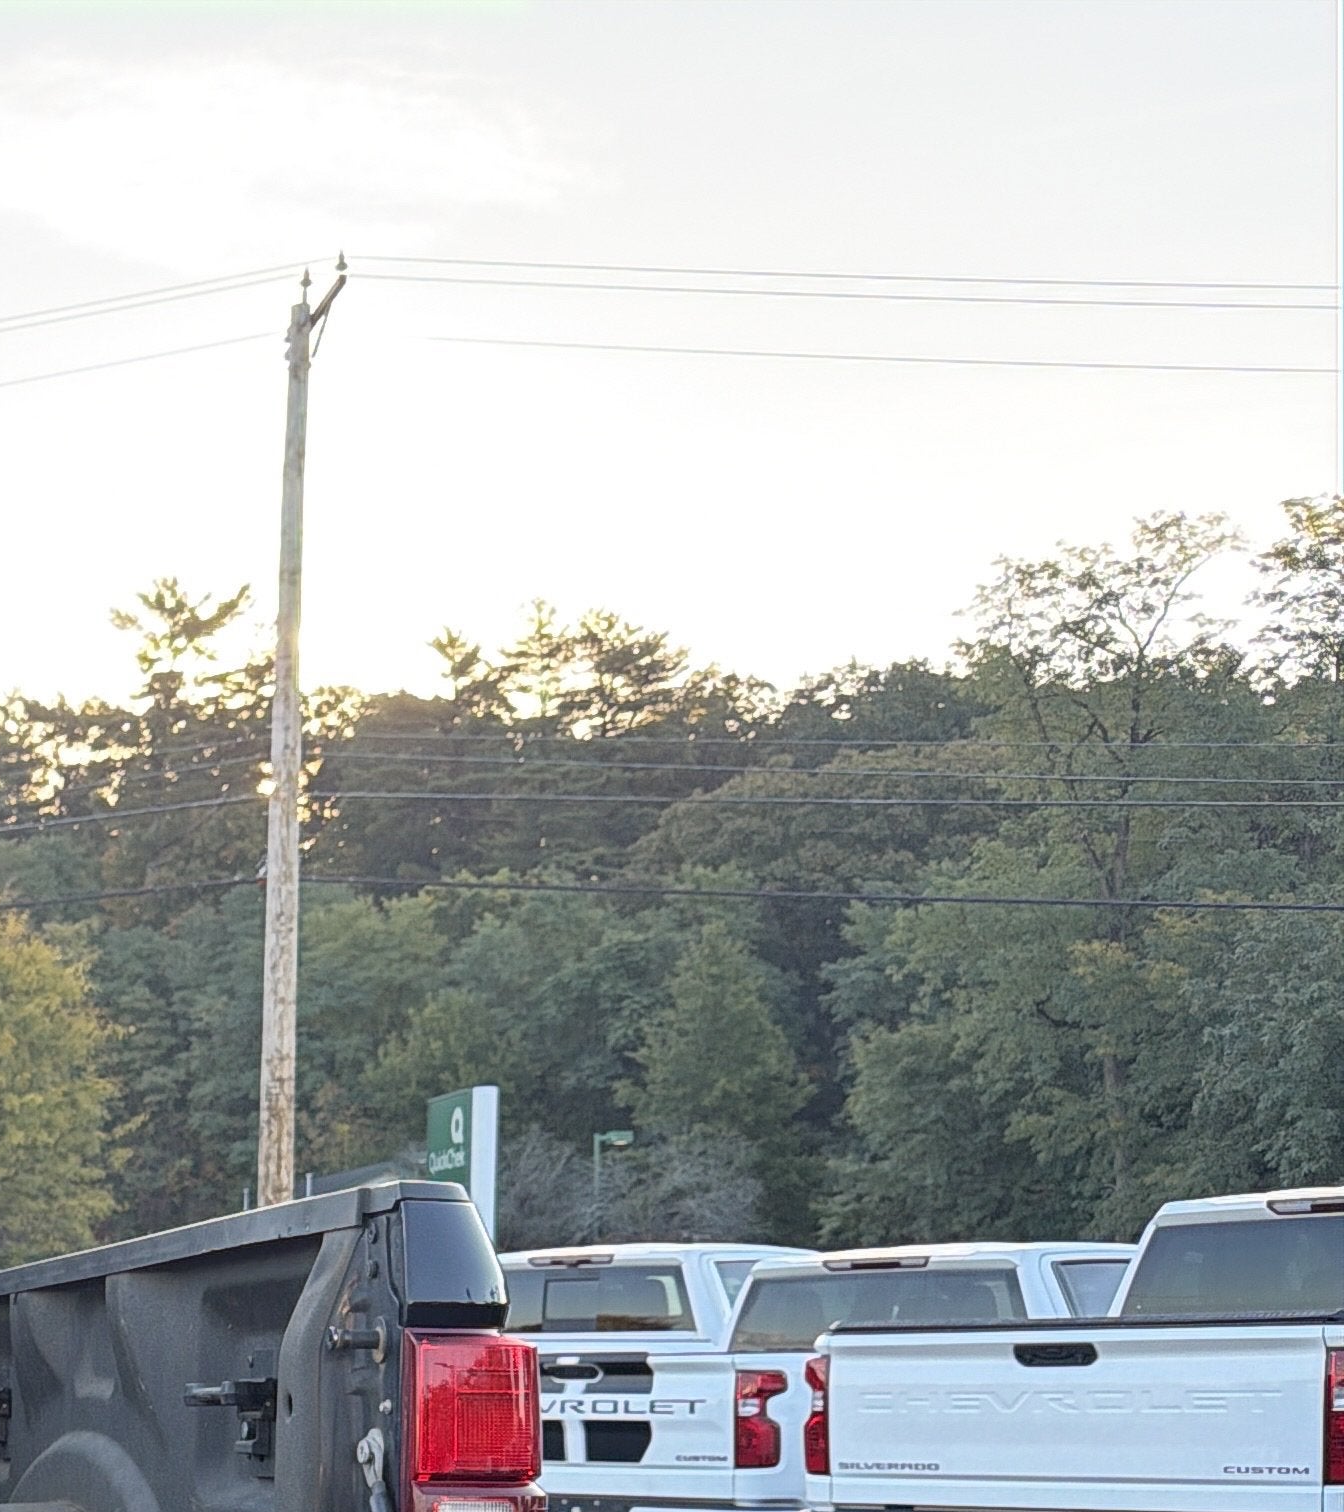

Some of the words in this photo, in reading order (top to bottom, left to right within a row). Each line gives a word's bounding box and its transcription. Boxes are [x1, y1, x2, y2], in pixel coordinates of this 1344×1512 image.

[857, 1390, 1284, 1415] CHEVROLET
[675, 1454, 728, 1462] CUSTOM
[838, 1462, 940, 1471] SILVERADO
[1223, 1465, 1310, 1475] CUSTOM
